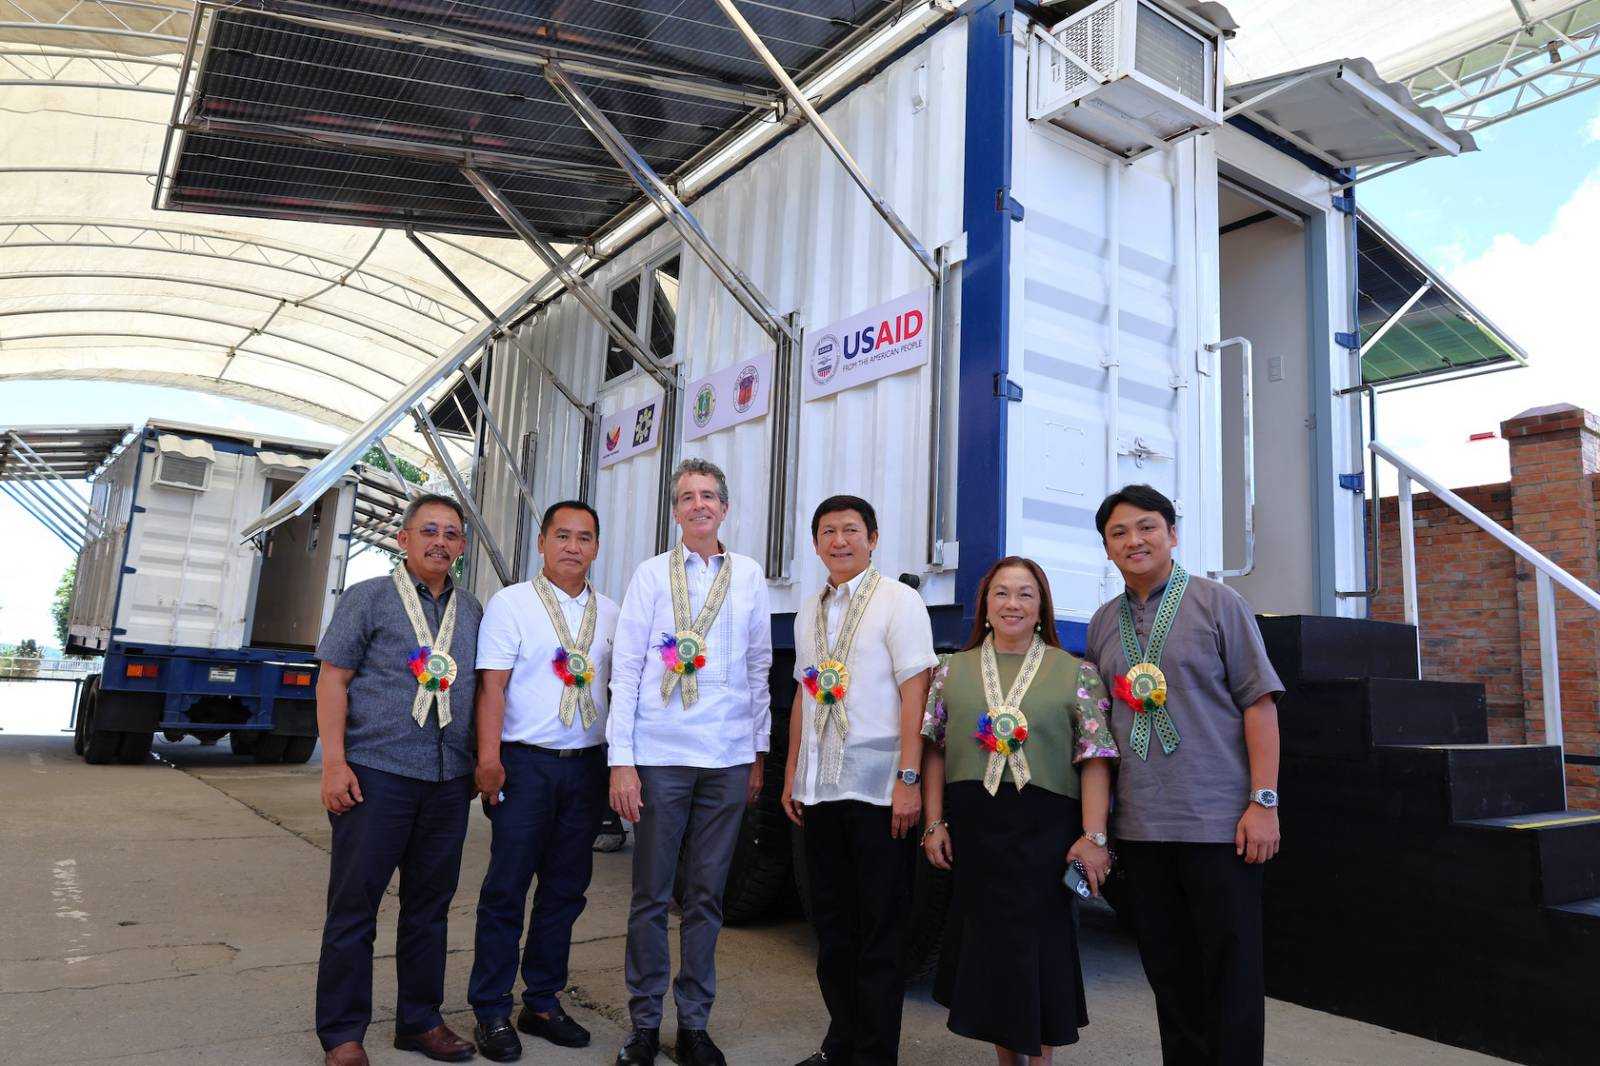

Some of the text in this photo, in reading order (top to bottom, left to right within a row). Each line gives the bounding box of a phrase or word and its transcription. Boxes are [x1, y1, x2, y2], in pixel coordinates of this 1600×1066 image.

[843, 309, 924, 360] USAID
[858, 357, 869, 367] THE
[869, 349, 898, 363] AMERICAN
[900, 340, 923, 353] PEOPLE
